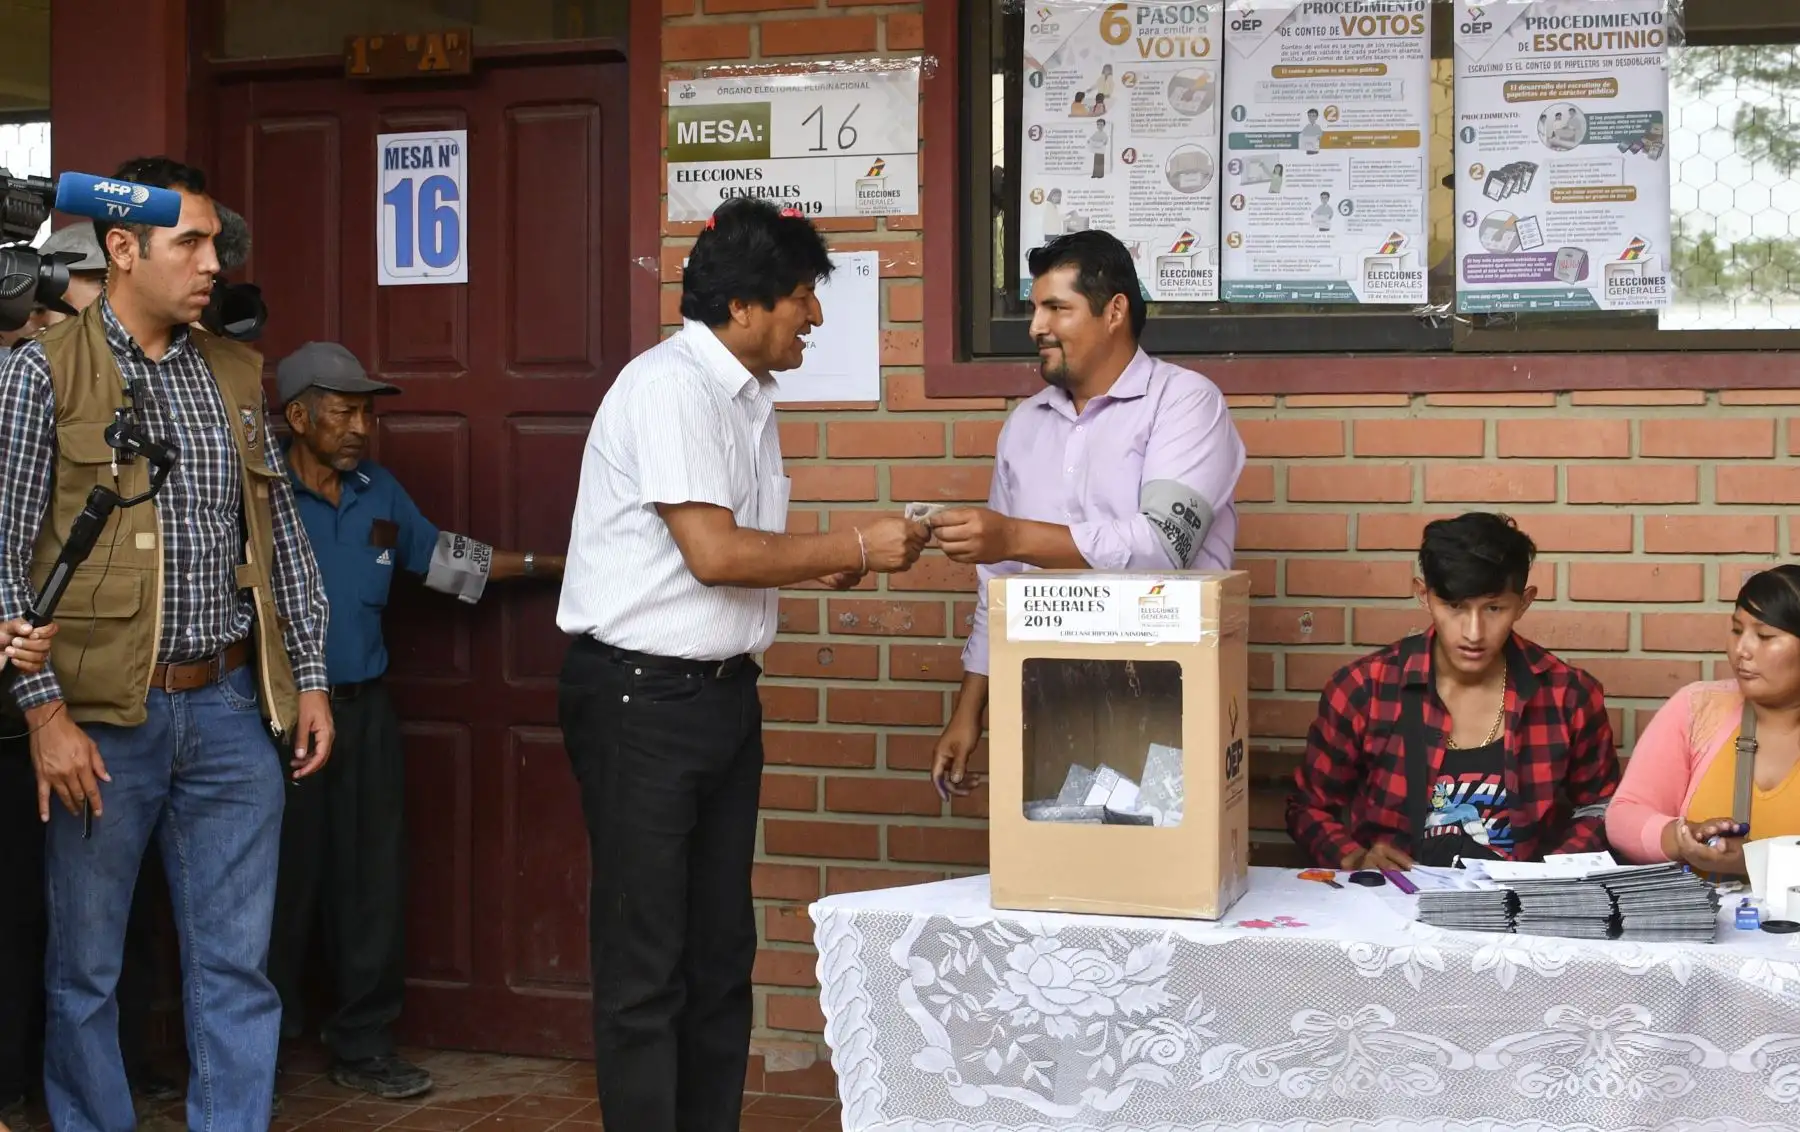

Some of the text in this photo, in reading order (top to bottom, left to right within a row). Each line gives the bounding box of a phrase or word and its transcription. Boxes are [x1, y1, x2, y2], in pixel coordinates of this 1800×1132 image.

[1303, 1, 1425, 14] PROCEDIMIENTO
[1099, 3, 1210, 45] 6 PASOS
[1231, 20, 1262, 31] OEP
[1281, 14, 1425, 37] DE CONTEO DE VOTOS
[1525, 11, 1663, 31] PROCEDIMIENTO
[1030, 24, 1060, 34] OEP
[1138, 27, 1160, 36] para
[1461, 22, 1492, 34] OEP
[1518, 29, 1664, 52] DE ESCRUTINIO
[1137, 36, 1210, 59] VOTO
[1525, 61, 1551, 70] CONTEO
[680, 91, 697, 100] OEP
[717, 86, 752, 96] ÓRGANO
[677, 119, 763, 145] MESA:
[802, 103, 861, 152] 16
[386, 146, 434, 171] MESA
[676, 167, 763, 183] ELECCIONES
[94, 181, 131, 196] AFP
[719, 184, 801, 200] GENERALES
[858, 190, 901, 198] ELECCIONES
[106, 203, 131, 217] TV
[383, 174, 460, 269] 16
[856, 265, 870, 277] 16
[1160, 269, 1213, 278] ELECCIONES
[1367, 271, 1423, 280] ELECCIONES
[1160, 278, 1213, 287] GENERALES
[1367, 280, 1423, 289] GENERALES
[1608, 276, 1666, 287] ELECCIONES
[1608, 286, 1666, 296] GENERALES
[1171, 502, 1202, 530] OEP
[1024, 585, 1111, 598] ELECCIONES
[1024, 599, 1105, 612] GENERALES
[1024, 615, 1063, 627] 2019
[1225, 738, 1244, 781] OEP
